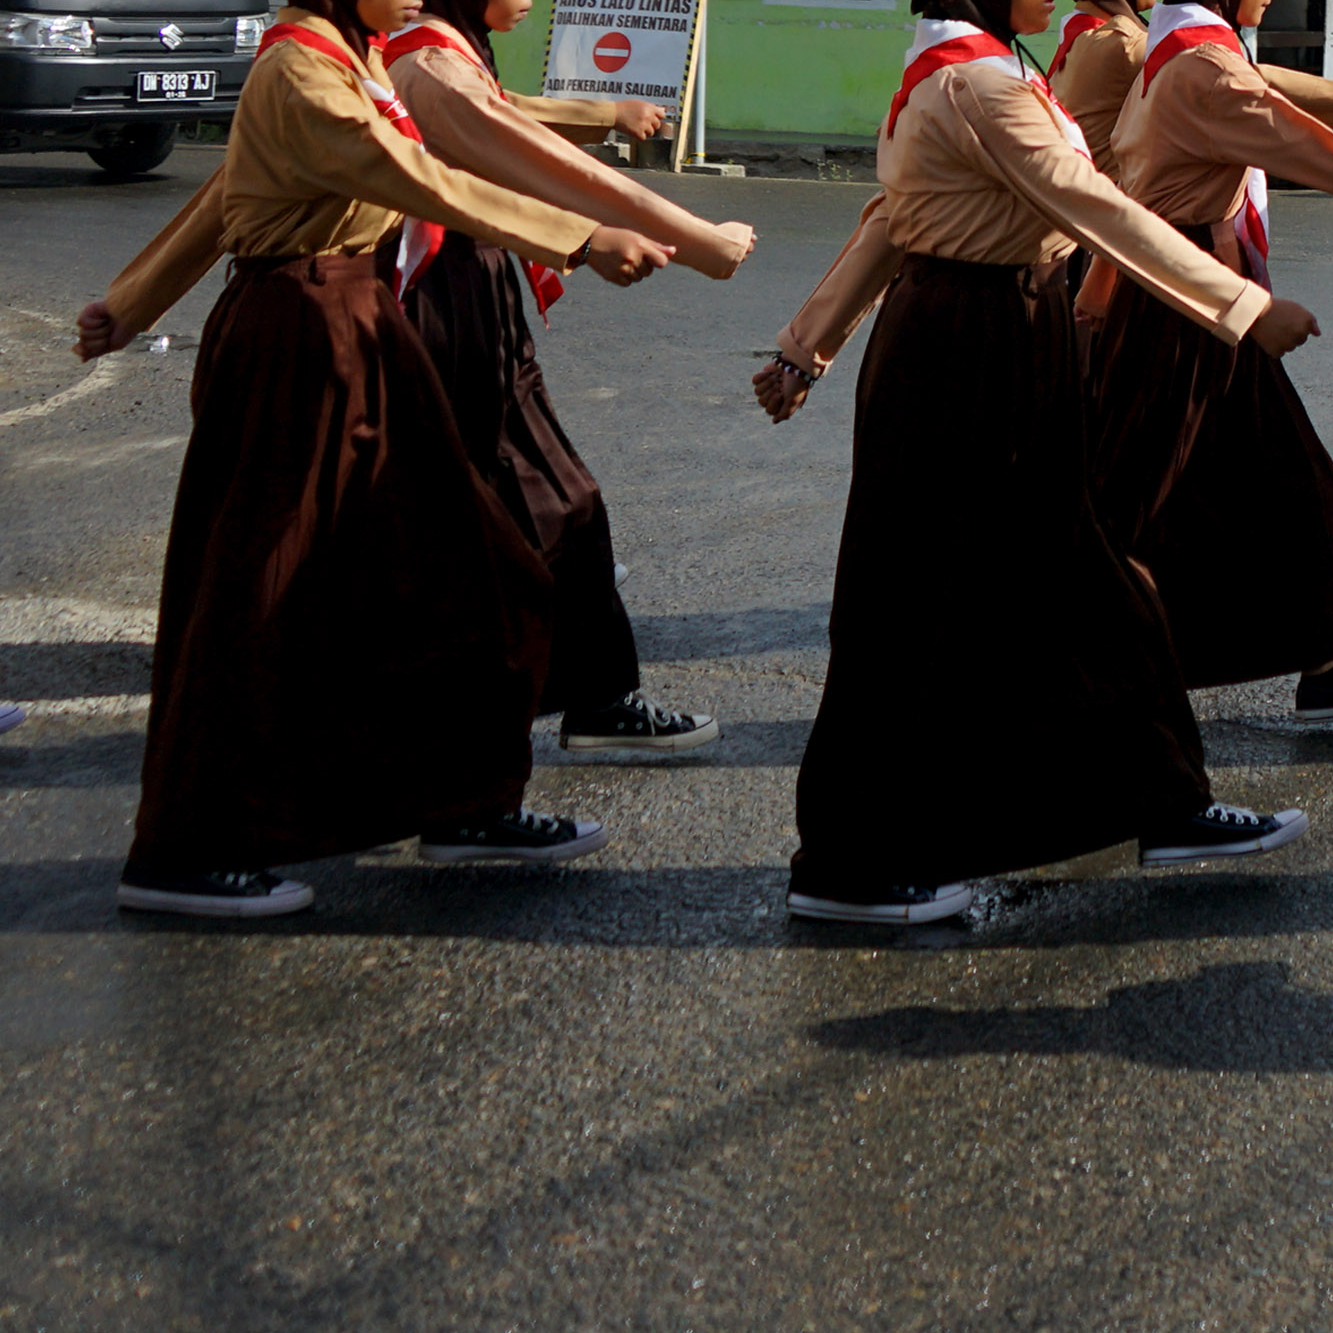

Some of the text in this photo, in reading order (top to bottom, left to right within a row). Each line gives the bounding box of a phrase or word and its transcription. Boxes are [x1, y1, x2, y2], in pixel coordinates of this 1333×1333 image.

[556, 12, 687, 32] DIALIHKAN SEMENTARA
[162, 74, 188, 90] 8313
[193, 73, 209, 90] AJ
[546, 79, 677, 98] ADA PEKERJAAN SALURAN
